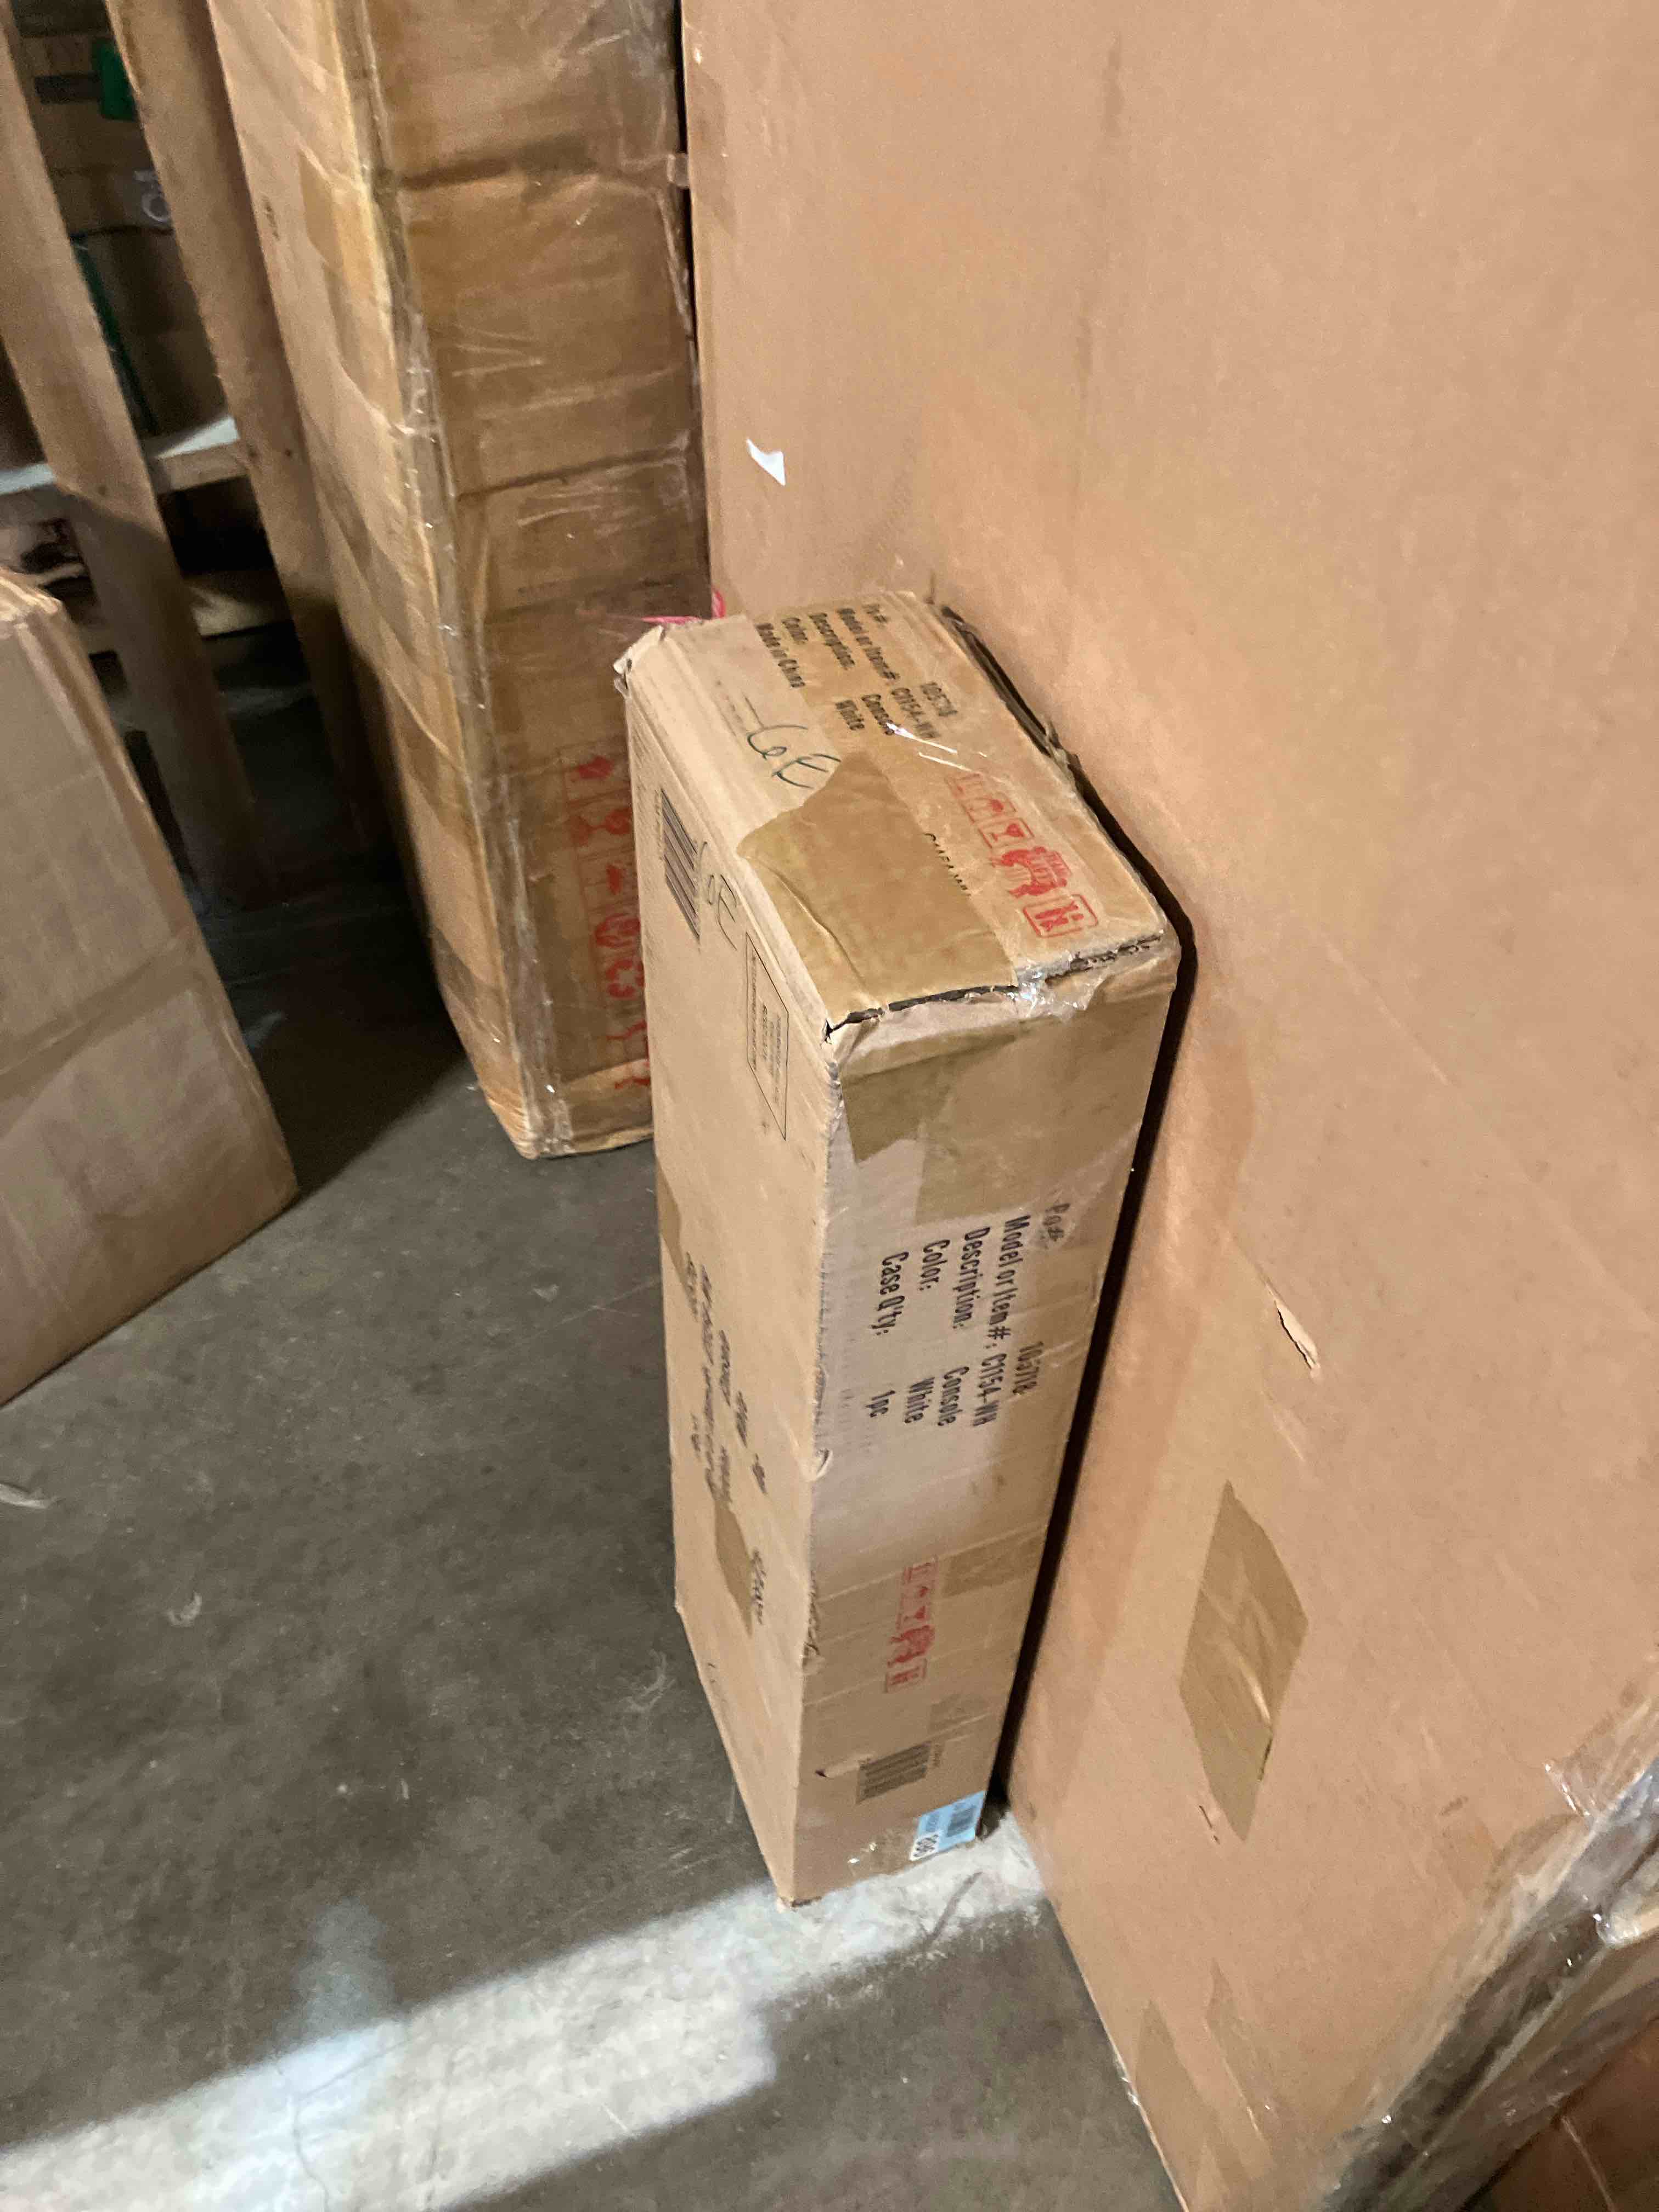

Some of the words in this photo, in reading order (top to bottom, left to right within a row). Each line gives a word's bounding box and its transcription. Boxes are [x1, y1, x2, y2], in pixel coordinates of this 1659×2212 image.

[861, 693, 896, 737] Consoe
[919, 1239, 951, 1291] Color:
[998, 1215, 1031, 1267] Model
[879, 1251, 909, 1295] Case
[952, 1226, 991, 1330] Description:
[995, 1269, 1016, 1286] or
[865, 1390, 896, 1418] 1pc
[904, 1376, 935, 1424] White
[937, 1365, 970, 1426] Console
